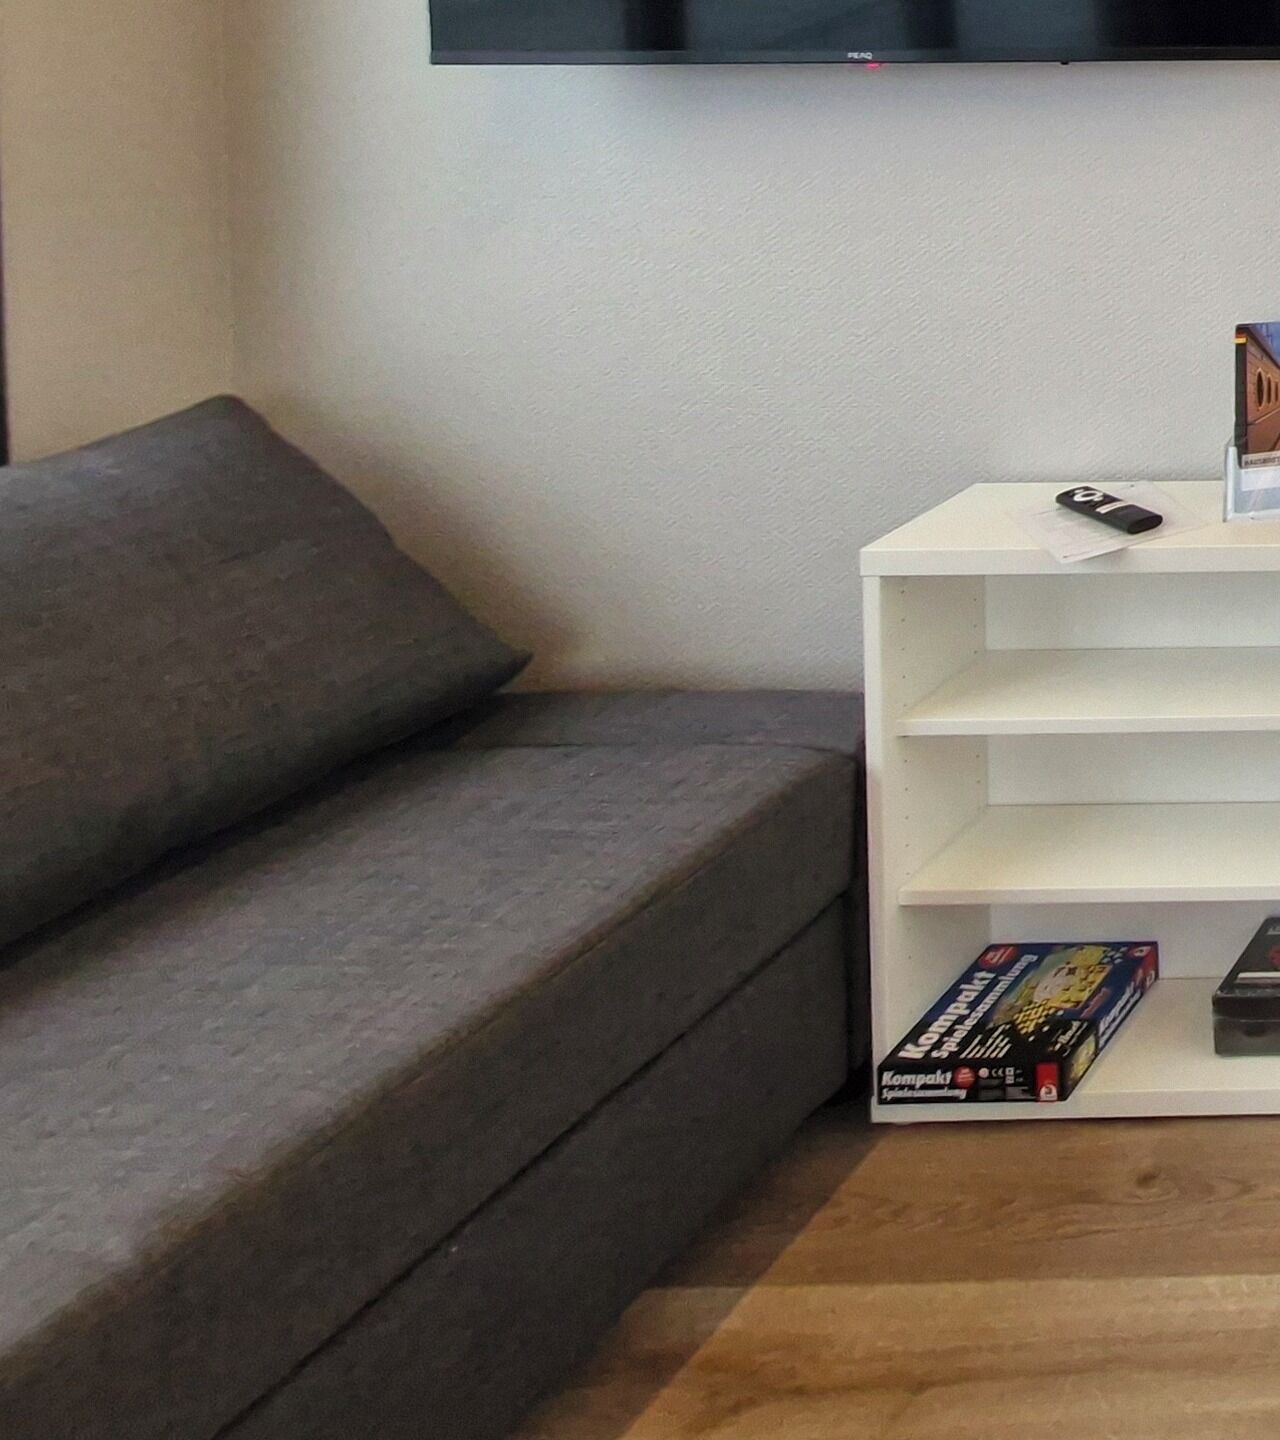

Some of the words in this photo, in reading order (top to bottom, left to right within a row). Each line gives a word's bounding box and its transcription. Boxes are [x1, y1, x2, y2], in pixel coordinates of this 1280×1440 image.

[898, 970, 997, 1059] Kompakt
[931, 954, 1039, 1059] Spielesammlung
[881, 1069, 953, 1088] Kompakt
